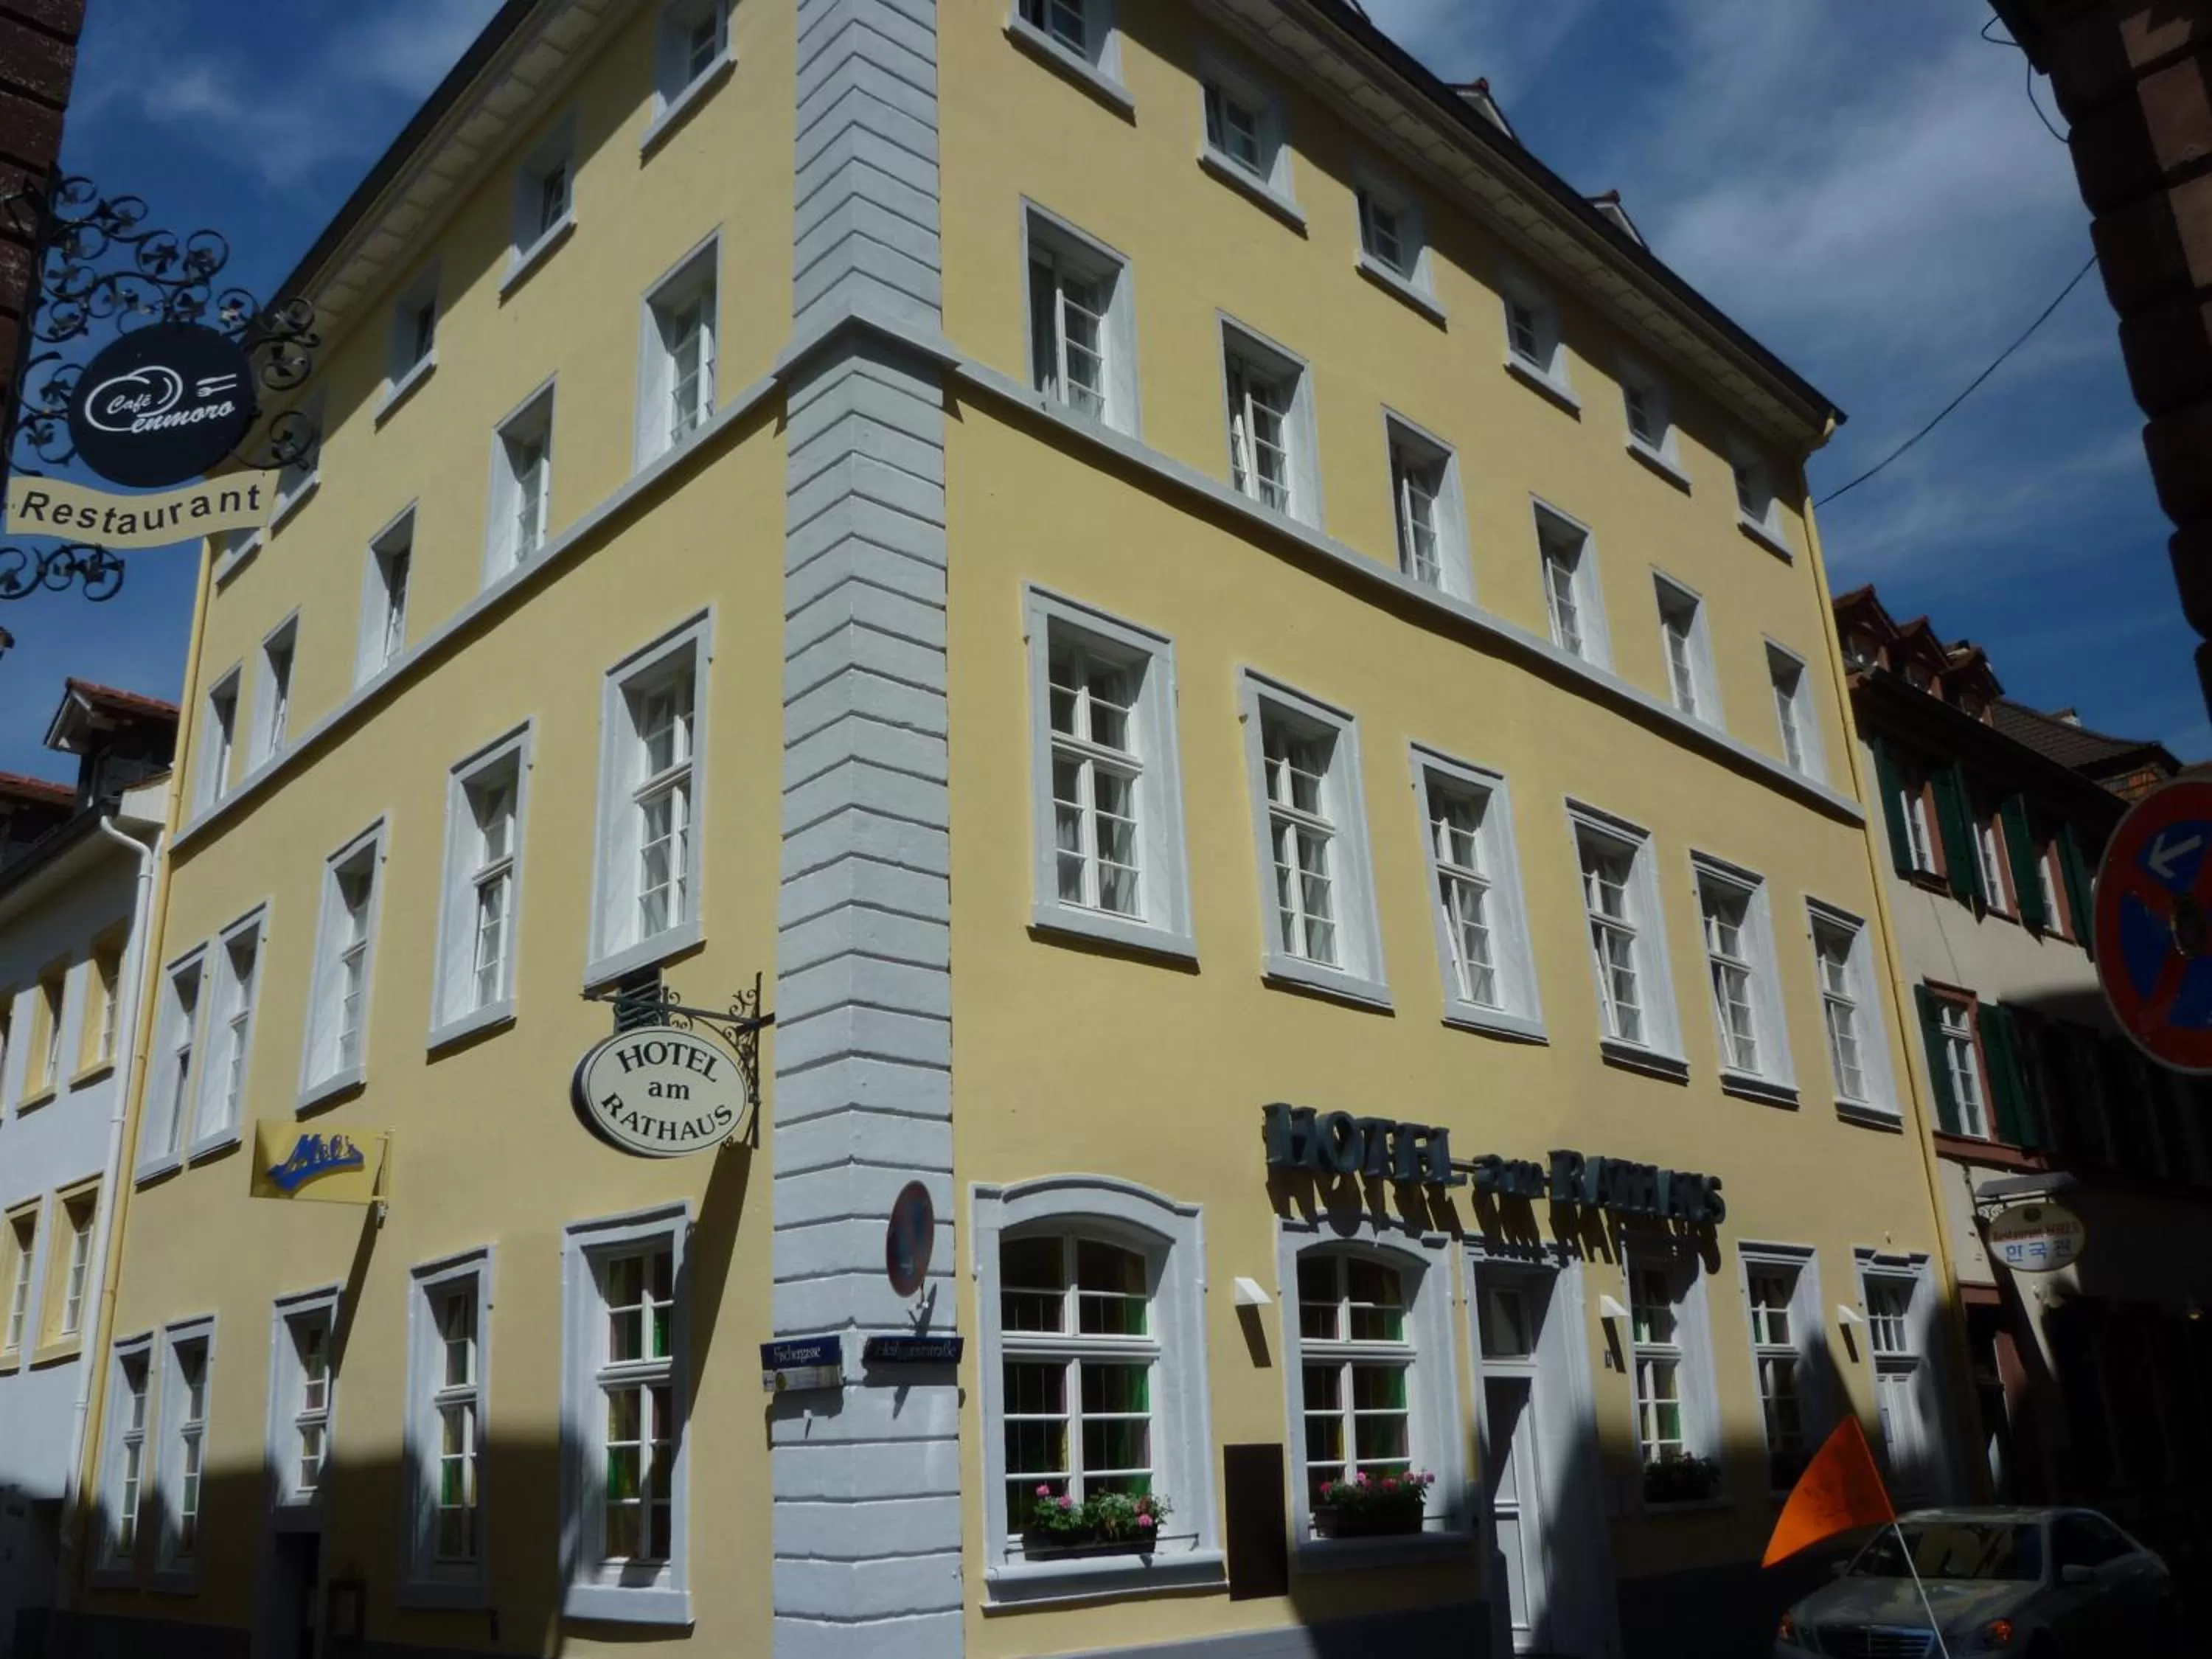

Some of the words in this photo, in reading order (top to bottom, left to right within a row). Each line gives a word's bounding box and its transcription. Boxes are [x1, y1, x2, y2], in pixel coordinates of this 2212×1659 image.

[19, 484, 261, 535] Restaurant
[616, 1040, 718, 1083] HOTEL
[647, 1081, 690, 1100] am
[601, 1092, 733, 1141] RATHAUS
[1262, 1102, 1467, 1189] HOTEL
